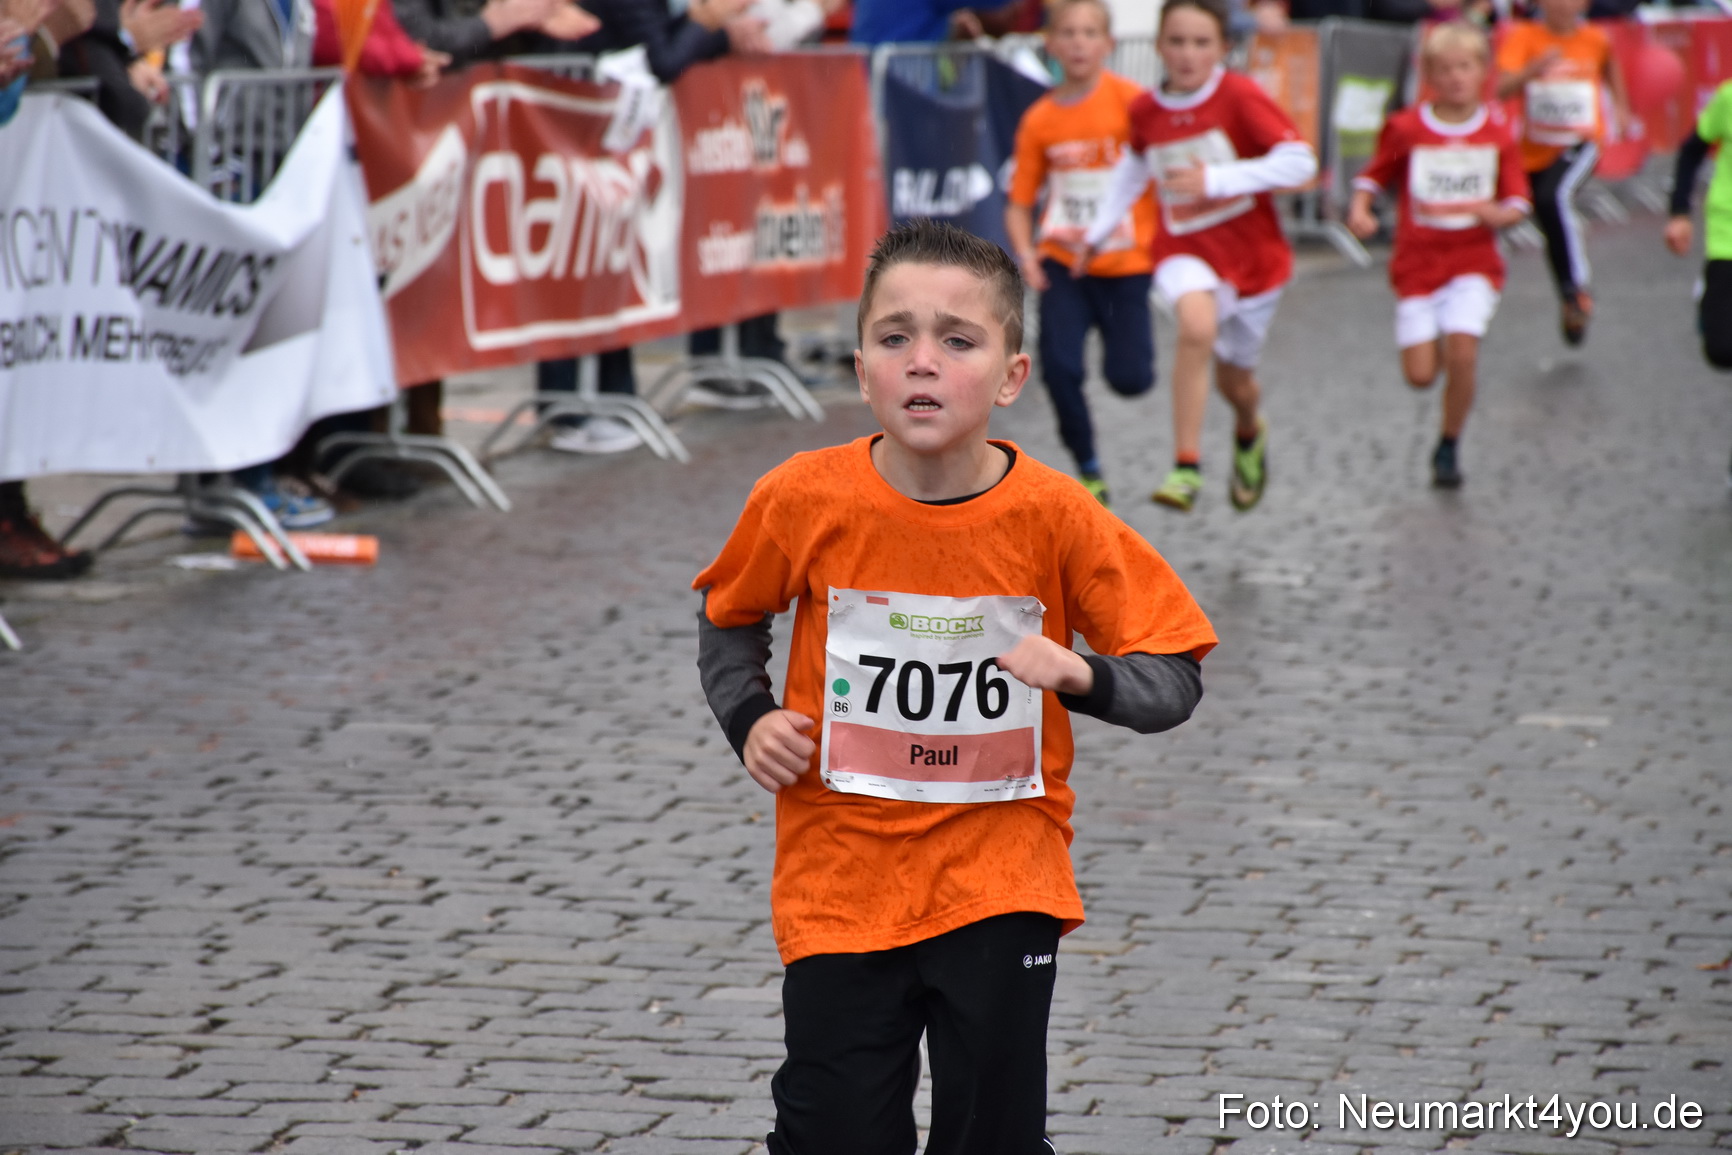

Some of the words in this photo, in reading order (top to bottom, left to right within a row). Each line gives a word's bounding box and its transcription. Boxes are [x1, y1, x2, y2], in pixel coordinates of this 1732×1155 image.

[911, 615, 984, 634] BOCK
[858, 654, 1009, 722] 7076
[834, 701, 849, 714] B6
[910, 744, 958, 766] Paul
[1034, 953, 1052, 966] JAKO
